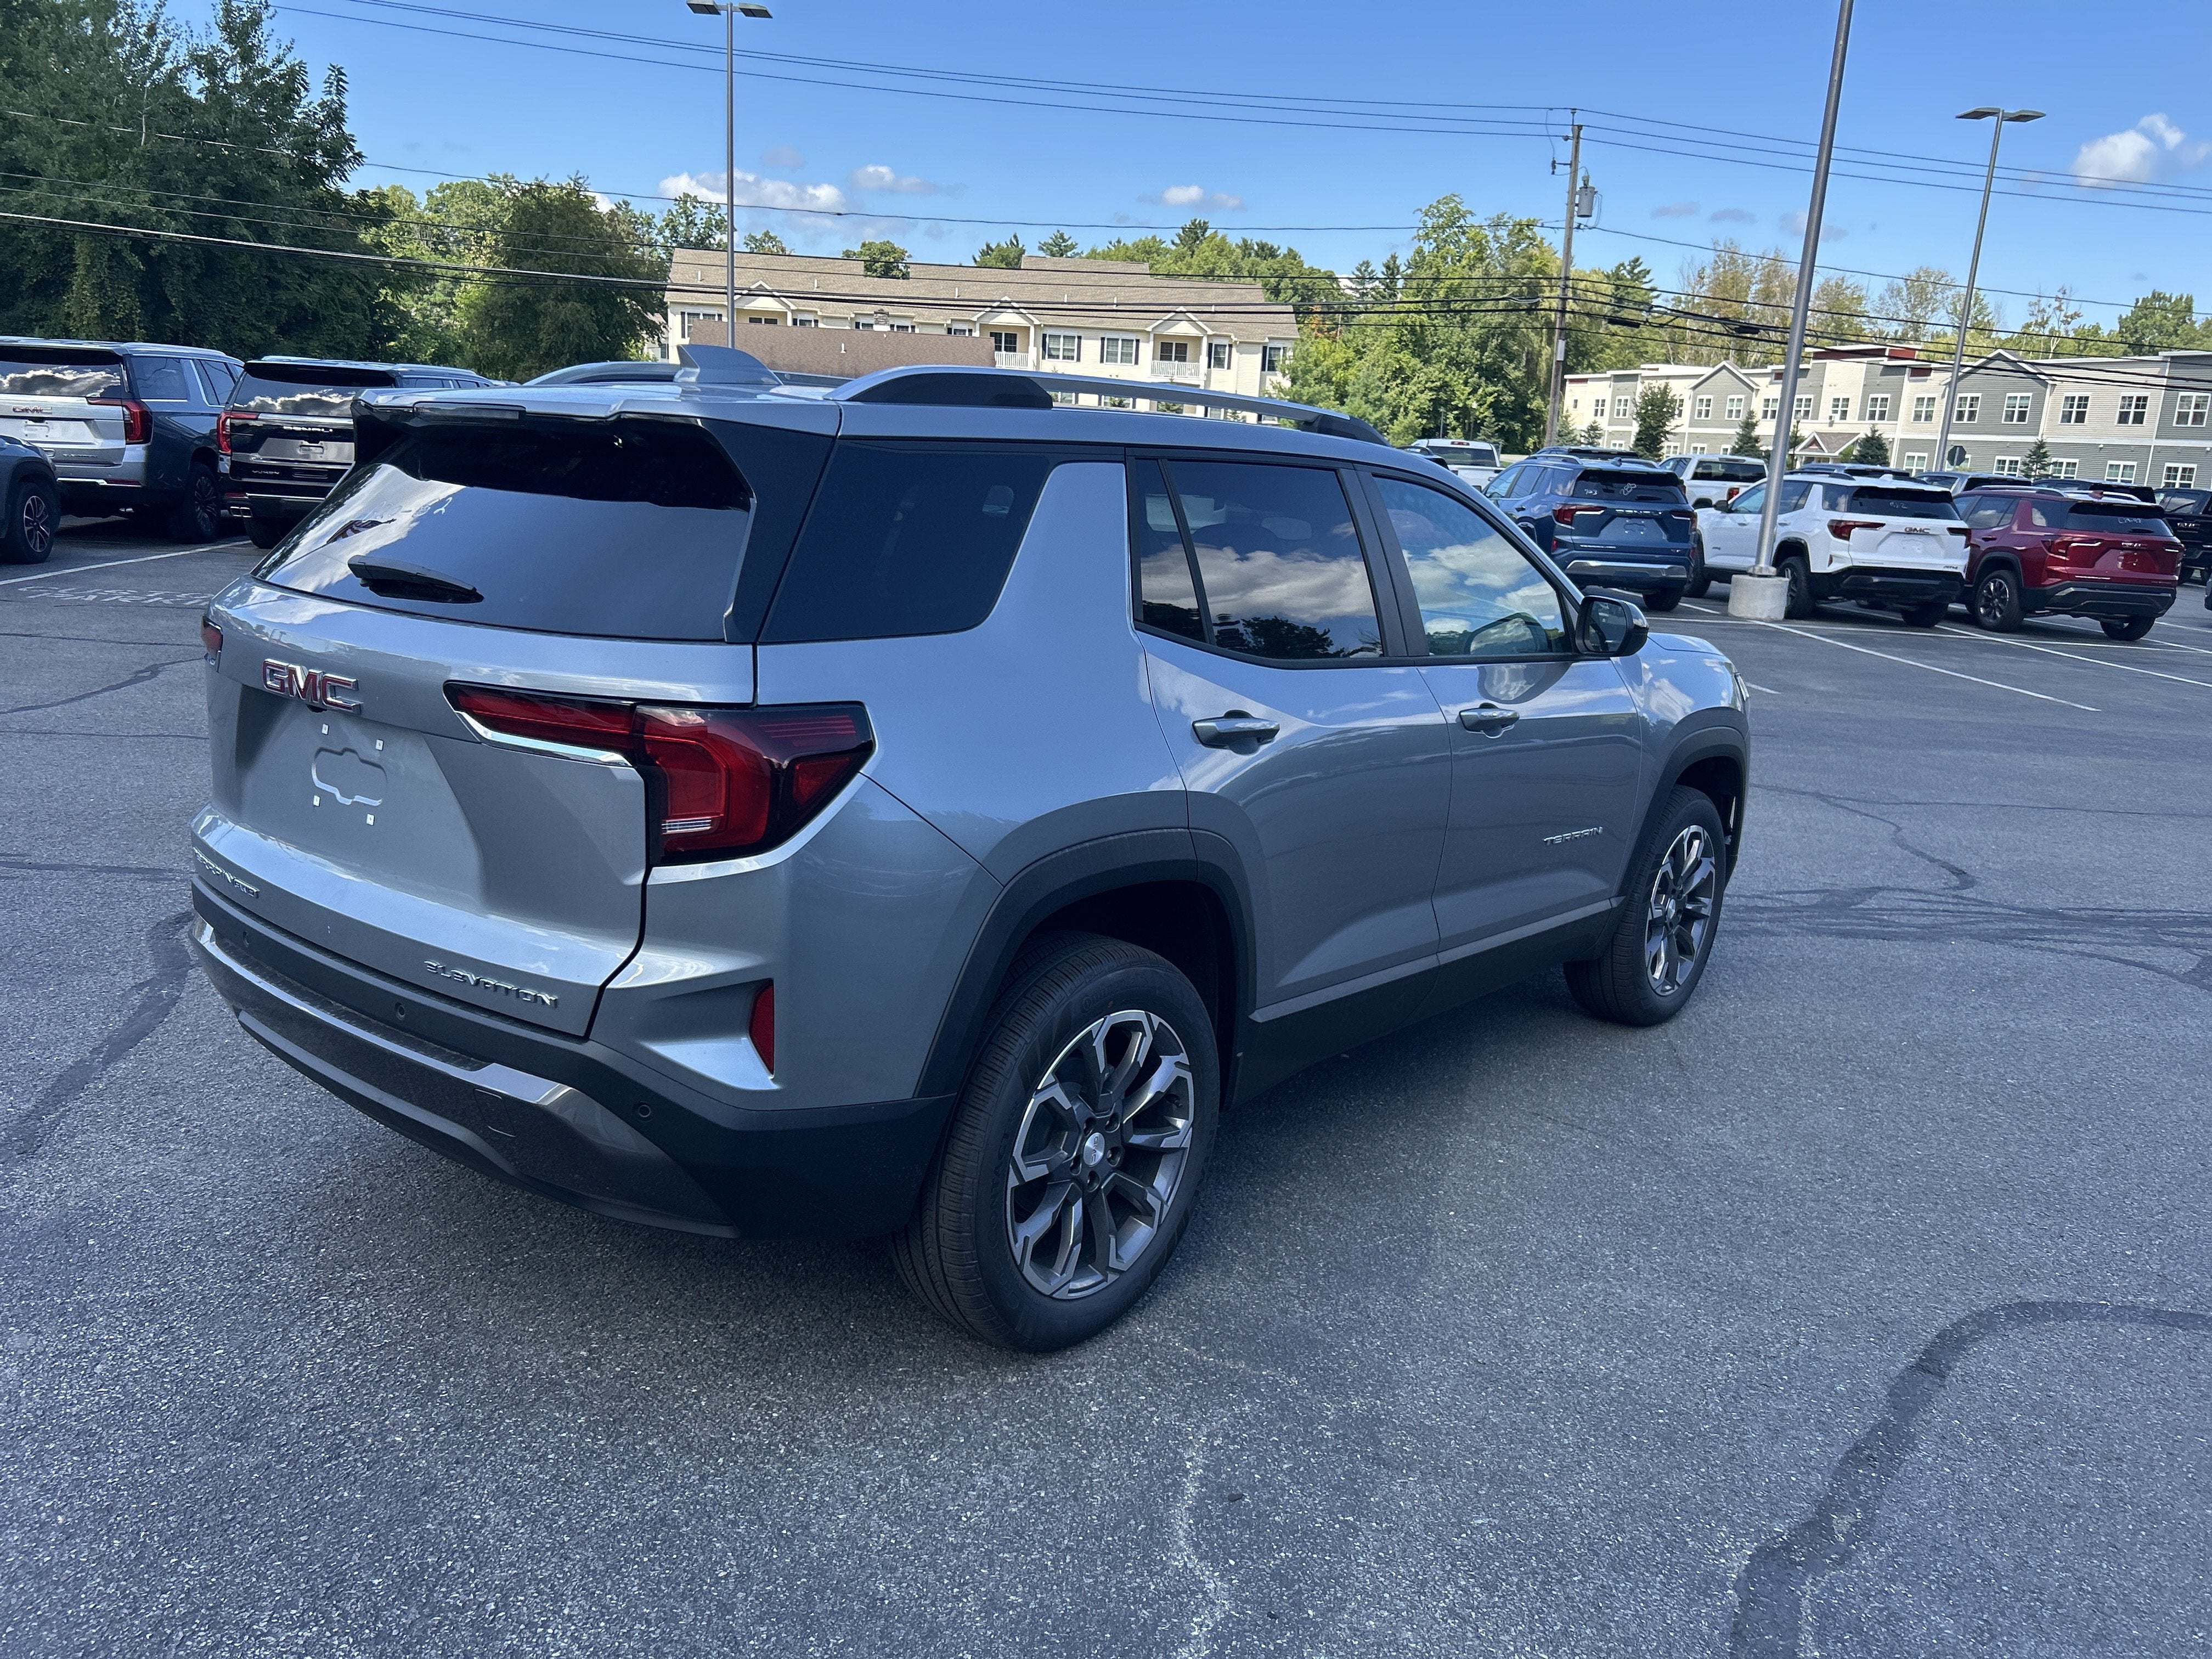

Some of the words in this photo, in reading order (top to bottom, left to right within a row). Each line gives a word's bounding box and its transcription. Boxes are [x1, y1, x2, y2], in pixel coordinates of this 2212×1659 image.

[12, 405, 53, 415] GMC
[263, 658, 364, 715] GMC
[1543, 826, 1602, 845] TERRAIN
[424, 960, 558, 1009] ELEVATION
